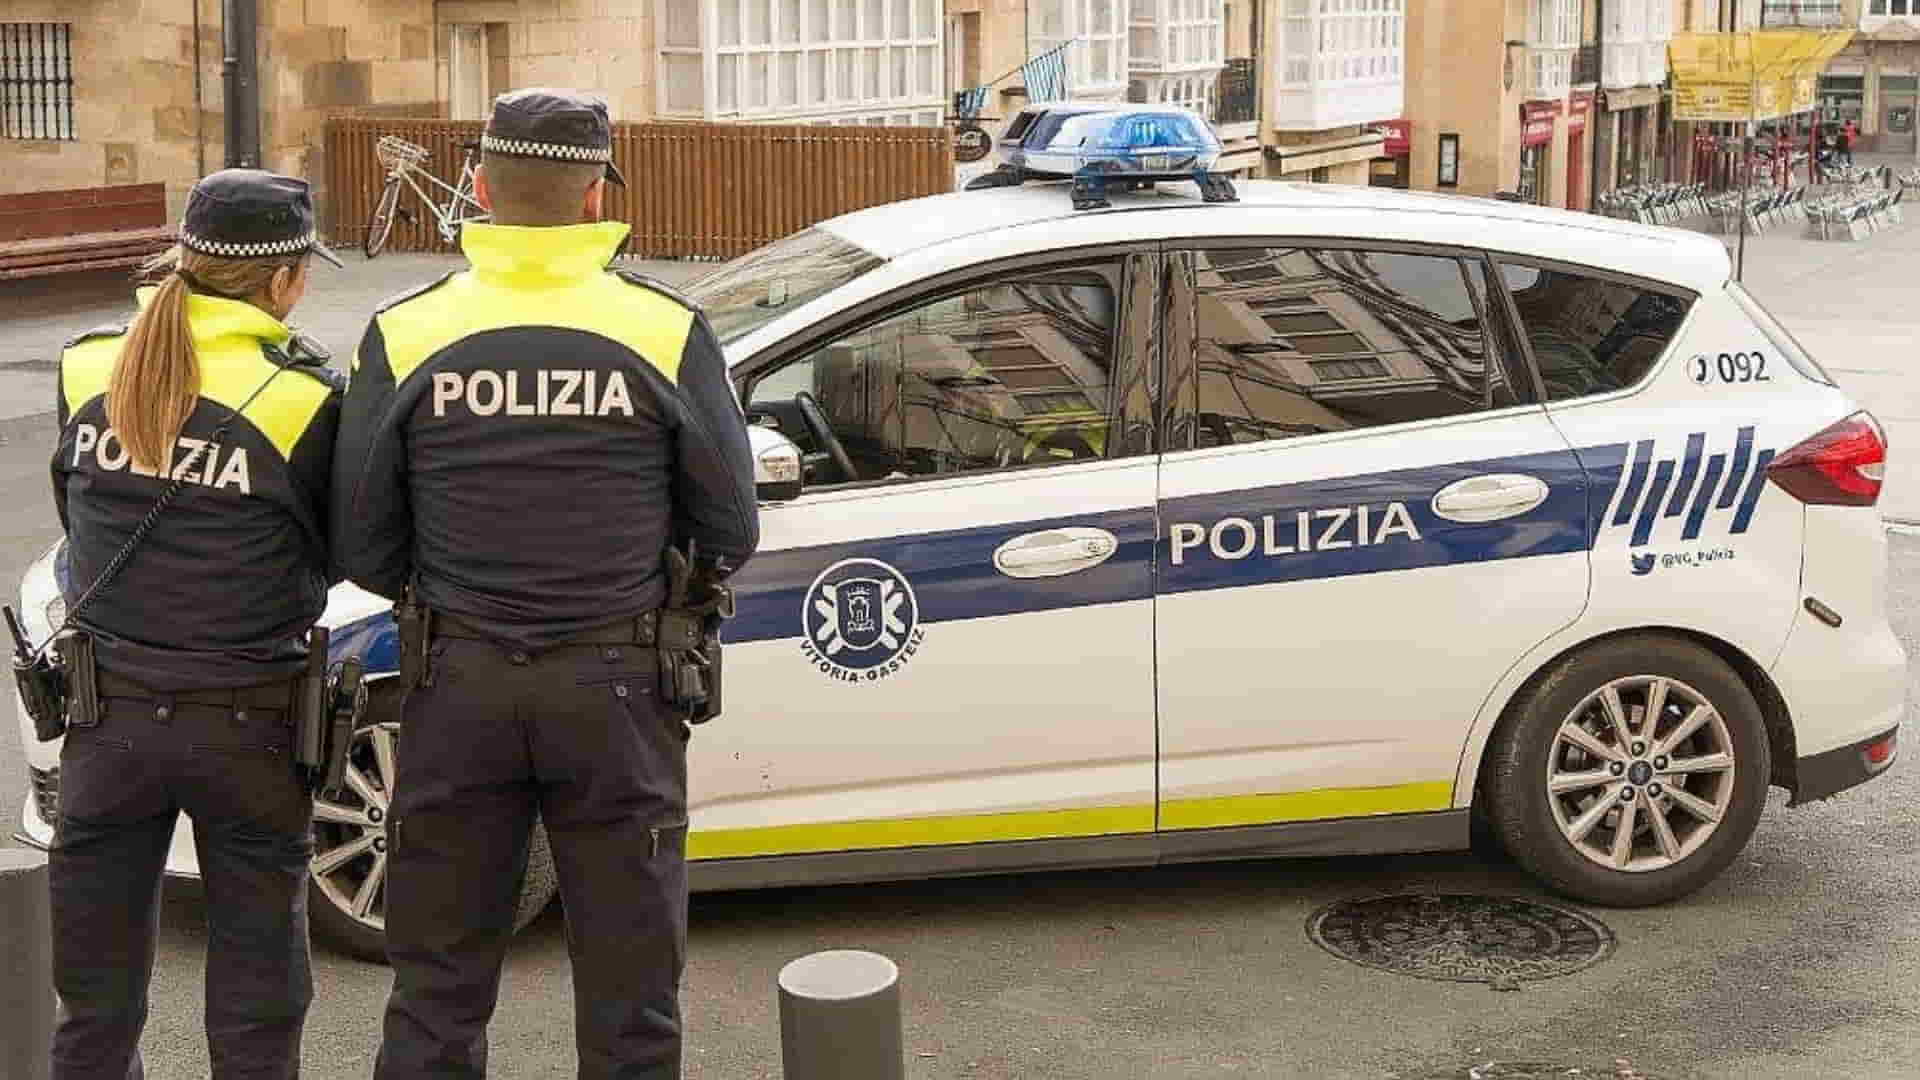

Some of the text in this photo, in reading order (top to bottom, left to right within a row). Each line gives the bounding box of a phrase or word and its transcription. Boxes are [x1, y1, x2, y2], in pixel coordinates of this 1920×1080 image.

[1718, 351, 1771, 383] 092
[432, 369, 635, 417] POLIZIA
[1169, 501, 1423, 565] POLIZIA
